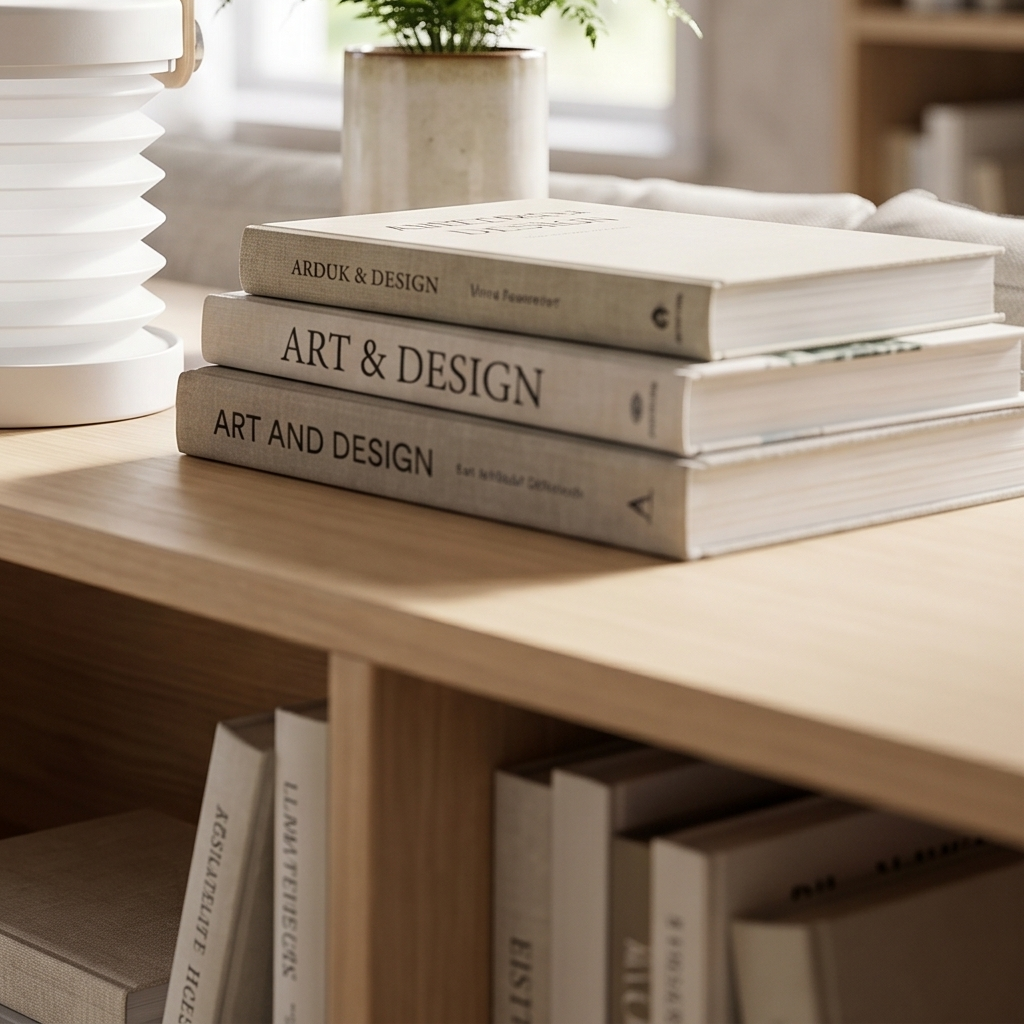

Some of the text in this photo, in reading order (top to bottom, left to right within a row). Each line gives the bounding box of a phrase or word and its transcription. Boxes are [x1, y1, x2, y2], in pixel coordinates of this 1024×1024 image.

[291, 259, 439, 294] ARDUK & DESIGN
[280, 326, 545, 409] ART & DESIGN
[213, 409, 434, 477] ART AND DESIGN
